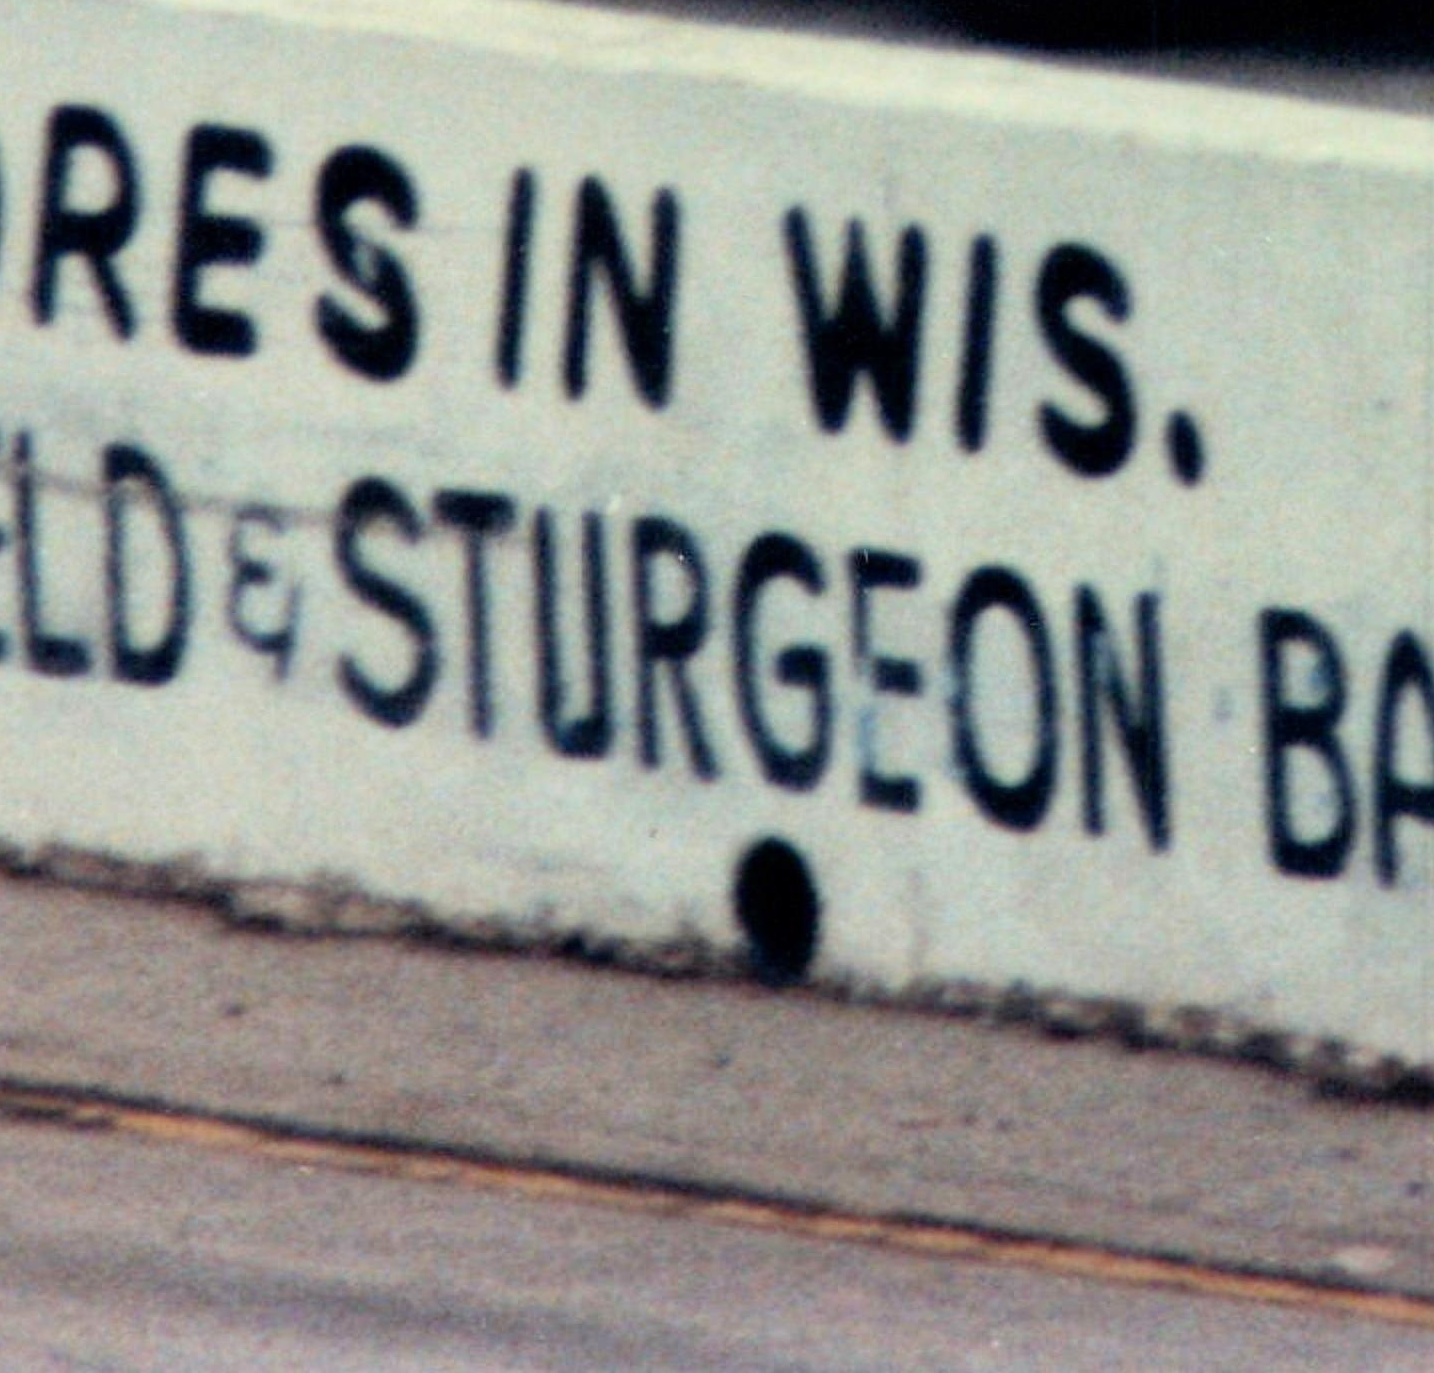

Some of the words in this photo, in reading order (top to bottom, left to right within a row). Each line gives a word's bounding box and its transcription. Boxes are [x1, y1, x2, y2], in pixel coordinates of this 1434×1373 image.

[493, 167, 683, 413] IN
[780, 204, 1208, 489] WIS.
[329, 472, 1175, 856] STURGEON
